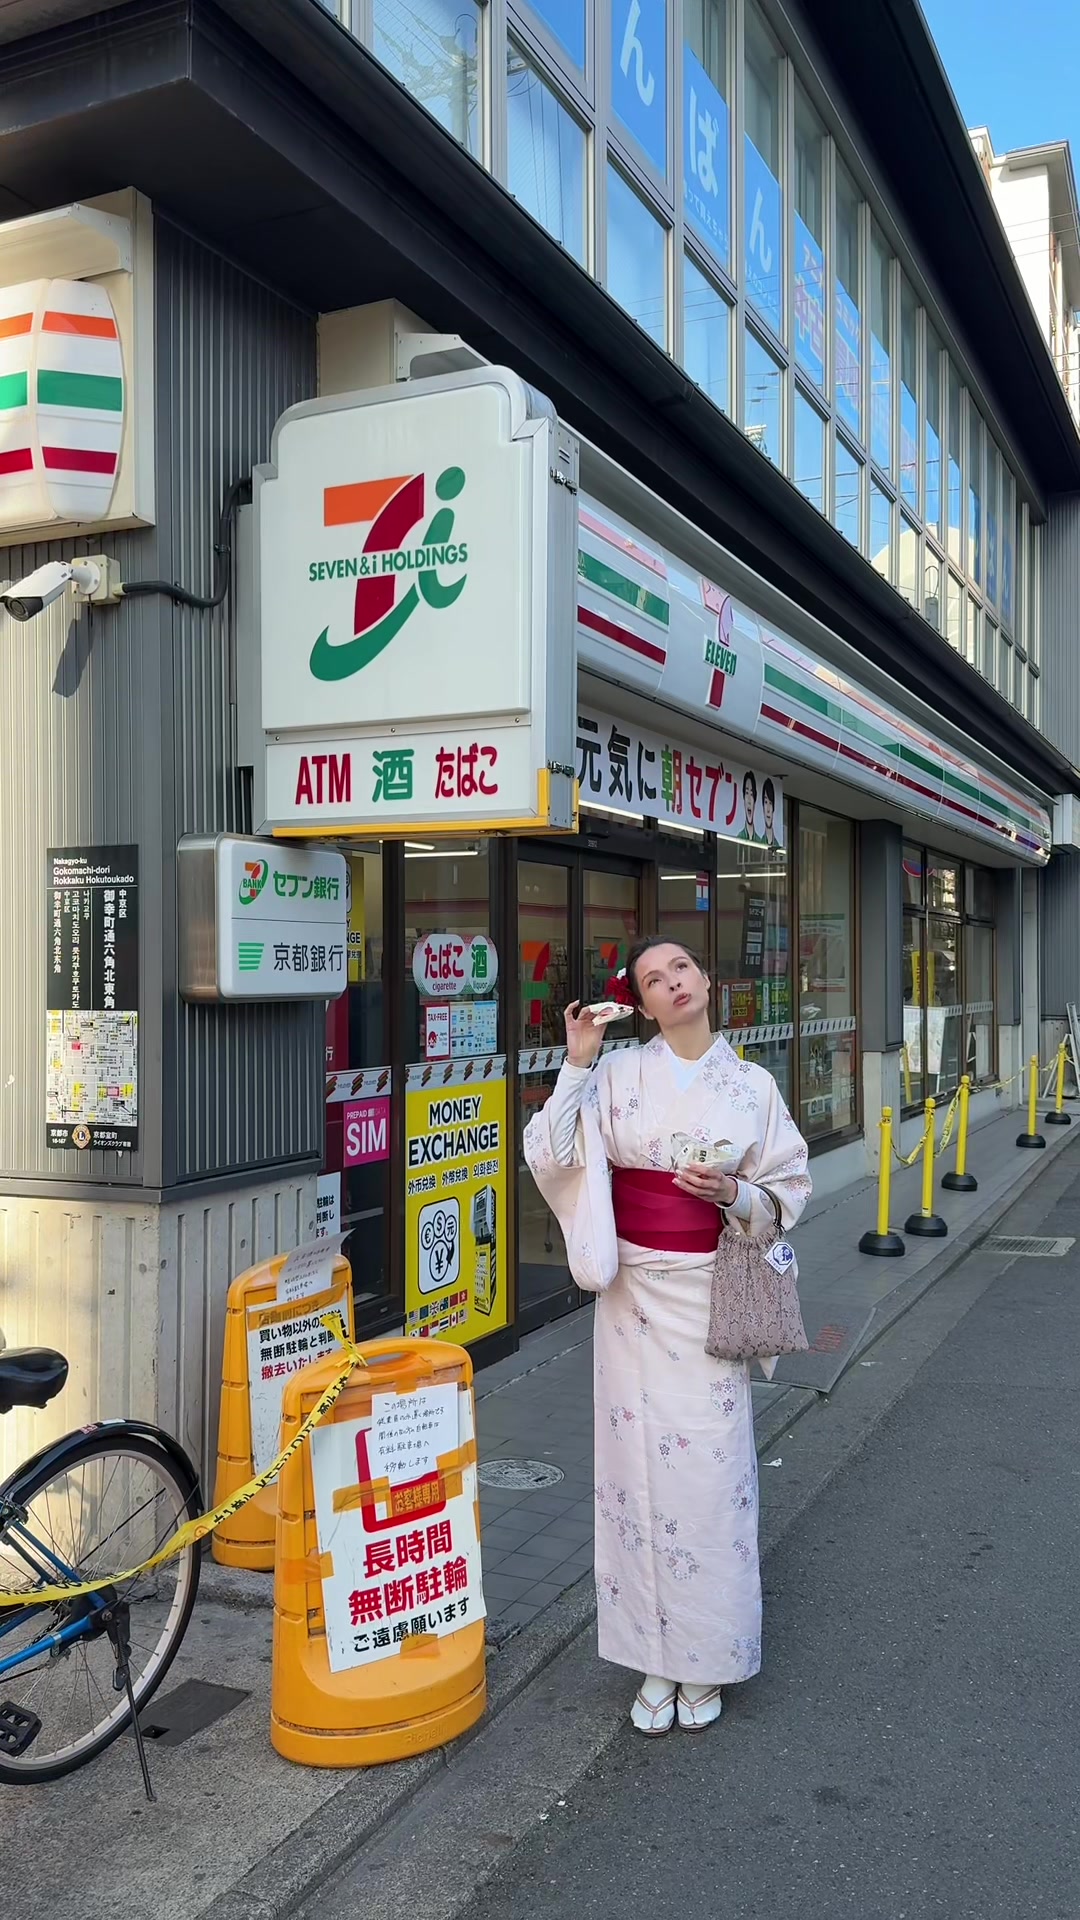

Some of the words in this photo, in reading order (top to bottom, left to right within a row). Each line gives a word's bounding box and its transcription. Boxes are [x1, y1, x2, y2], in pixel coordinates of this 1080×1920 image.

[309, 558, 357, 582] SEVEN
[359, 556, 370, 575] &
[382, 543, 468, 572] HOLDINGS
[295, 753, 351, 805] ATM
[372, 749, 414, 802] 酒
[435, 742, 498, 798] たばこ
[576, 715, 738, 826] 元気に朝セブン
[53, 857, 88, 866] Nakagyo-ku
[53, 865, 110, 875] Gokomachi-dori
[53, 876, 84, 885] Rokkaku
[86, 874, 134, 884] Hokutoukado
[243, 878, 263, 889] BANK
[273, 871, 339, 900] セブン銀行
[119, 889, 127, 918] 中京区
[103, 889, 115, 1009] 御幸町通六角北東角
[273, 943, 344, 972] 京都銀行
[424, 943, 464, 979] たばこ
[472, 944, 488, 978] 酒
[432, 981, 457, 992] cigarette
[428, 1013, 448, 1021] TAX-FREE
[347, 1109, 367, 1120] PREPAID
[429, 1097, 481, 1126] MONEY
[347, 1119, 387, 1157] SIM
[409, 1123, 498, 1167] EXCHANGE
[363, 1519, 453, 1579] 長時間
[348, 1556, 469, 1626] 無断駐輪
[353, 1597, 470, 1652] ご遠慮願います
